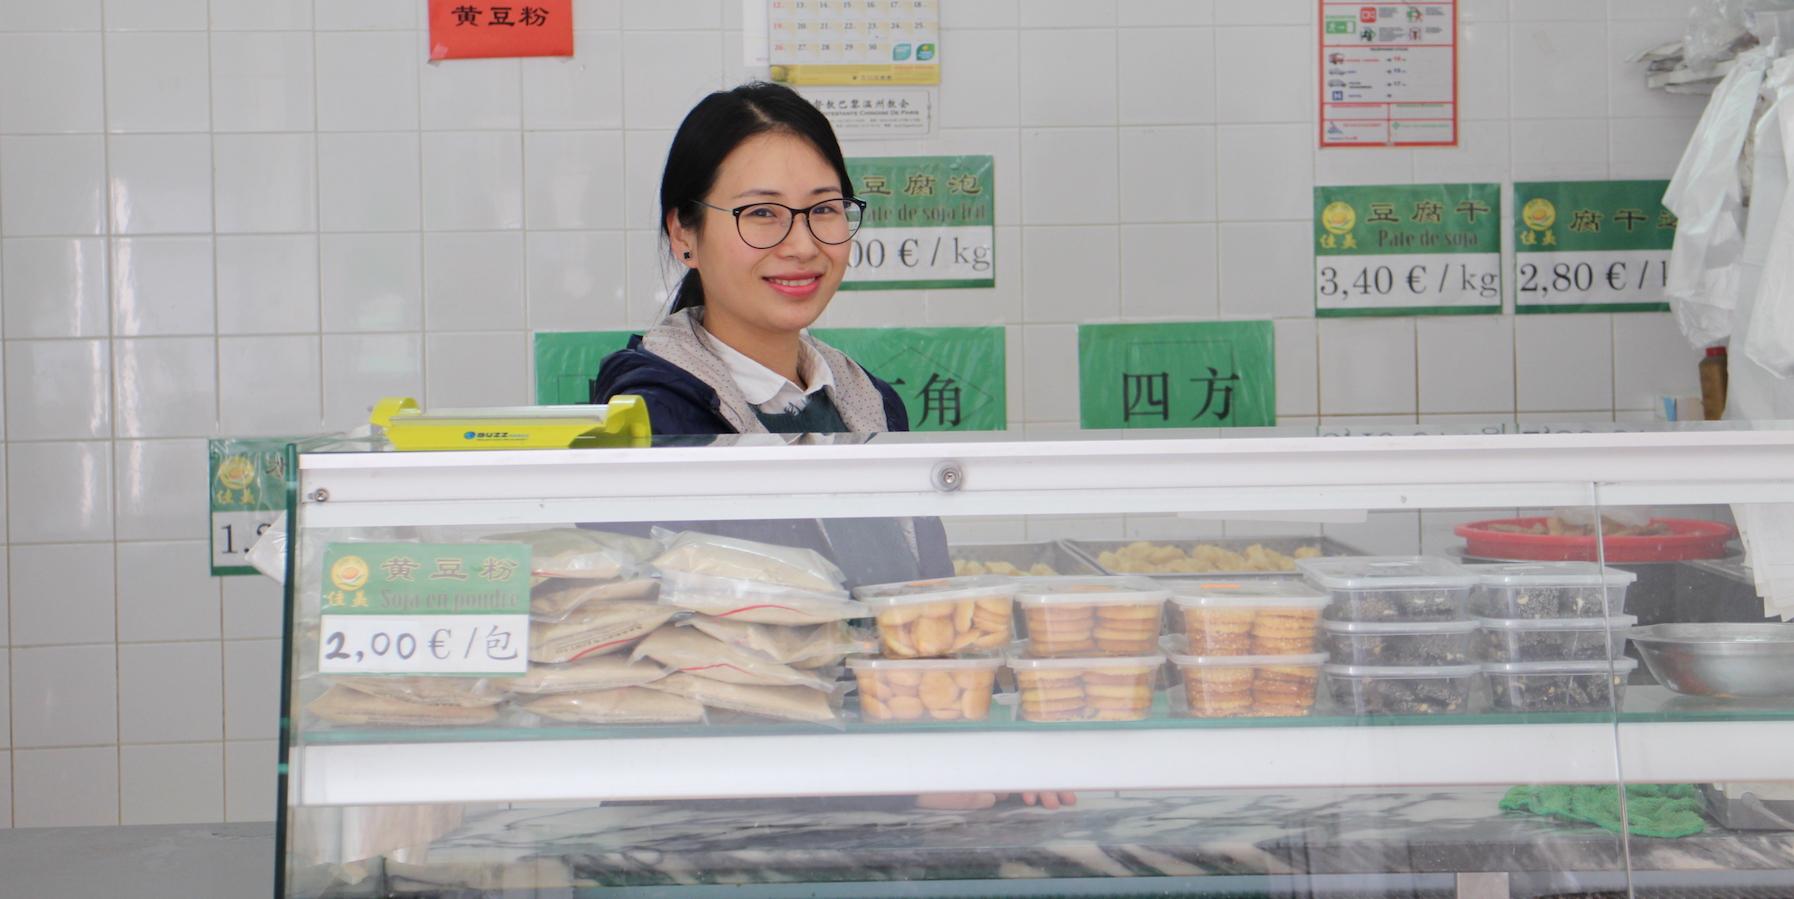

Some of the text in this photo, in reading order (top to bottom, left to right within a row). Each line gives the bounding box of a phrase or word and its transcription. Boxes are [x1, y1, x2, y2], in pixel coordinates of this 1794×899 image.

[450, 5, 549, 27] 黄豆粉
[859, 173, 983, 196] 豆腐泡
[1366, 201, 1491, 224] 豆腐干
[1419, 229, 1441, 247] de
[898, 238, 920, 268] €
[930, 236, 942, 267] /
[953, 236, 991, 272] kg
[1320, 263, 1498, 300] 3,40 € / kg
[1520, 262, 1593, 298] 2,80
[1605, 261, 1627, 291] €
[1638, 259, 1649, 290] /
[1122, 366, 1240, 422] 四方
[381, 556, 519, 582] 黄豆粉
[325, 631, 417, 663] 2,00
[427, 628, 452, 660] €
